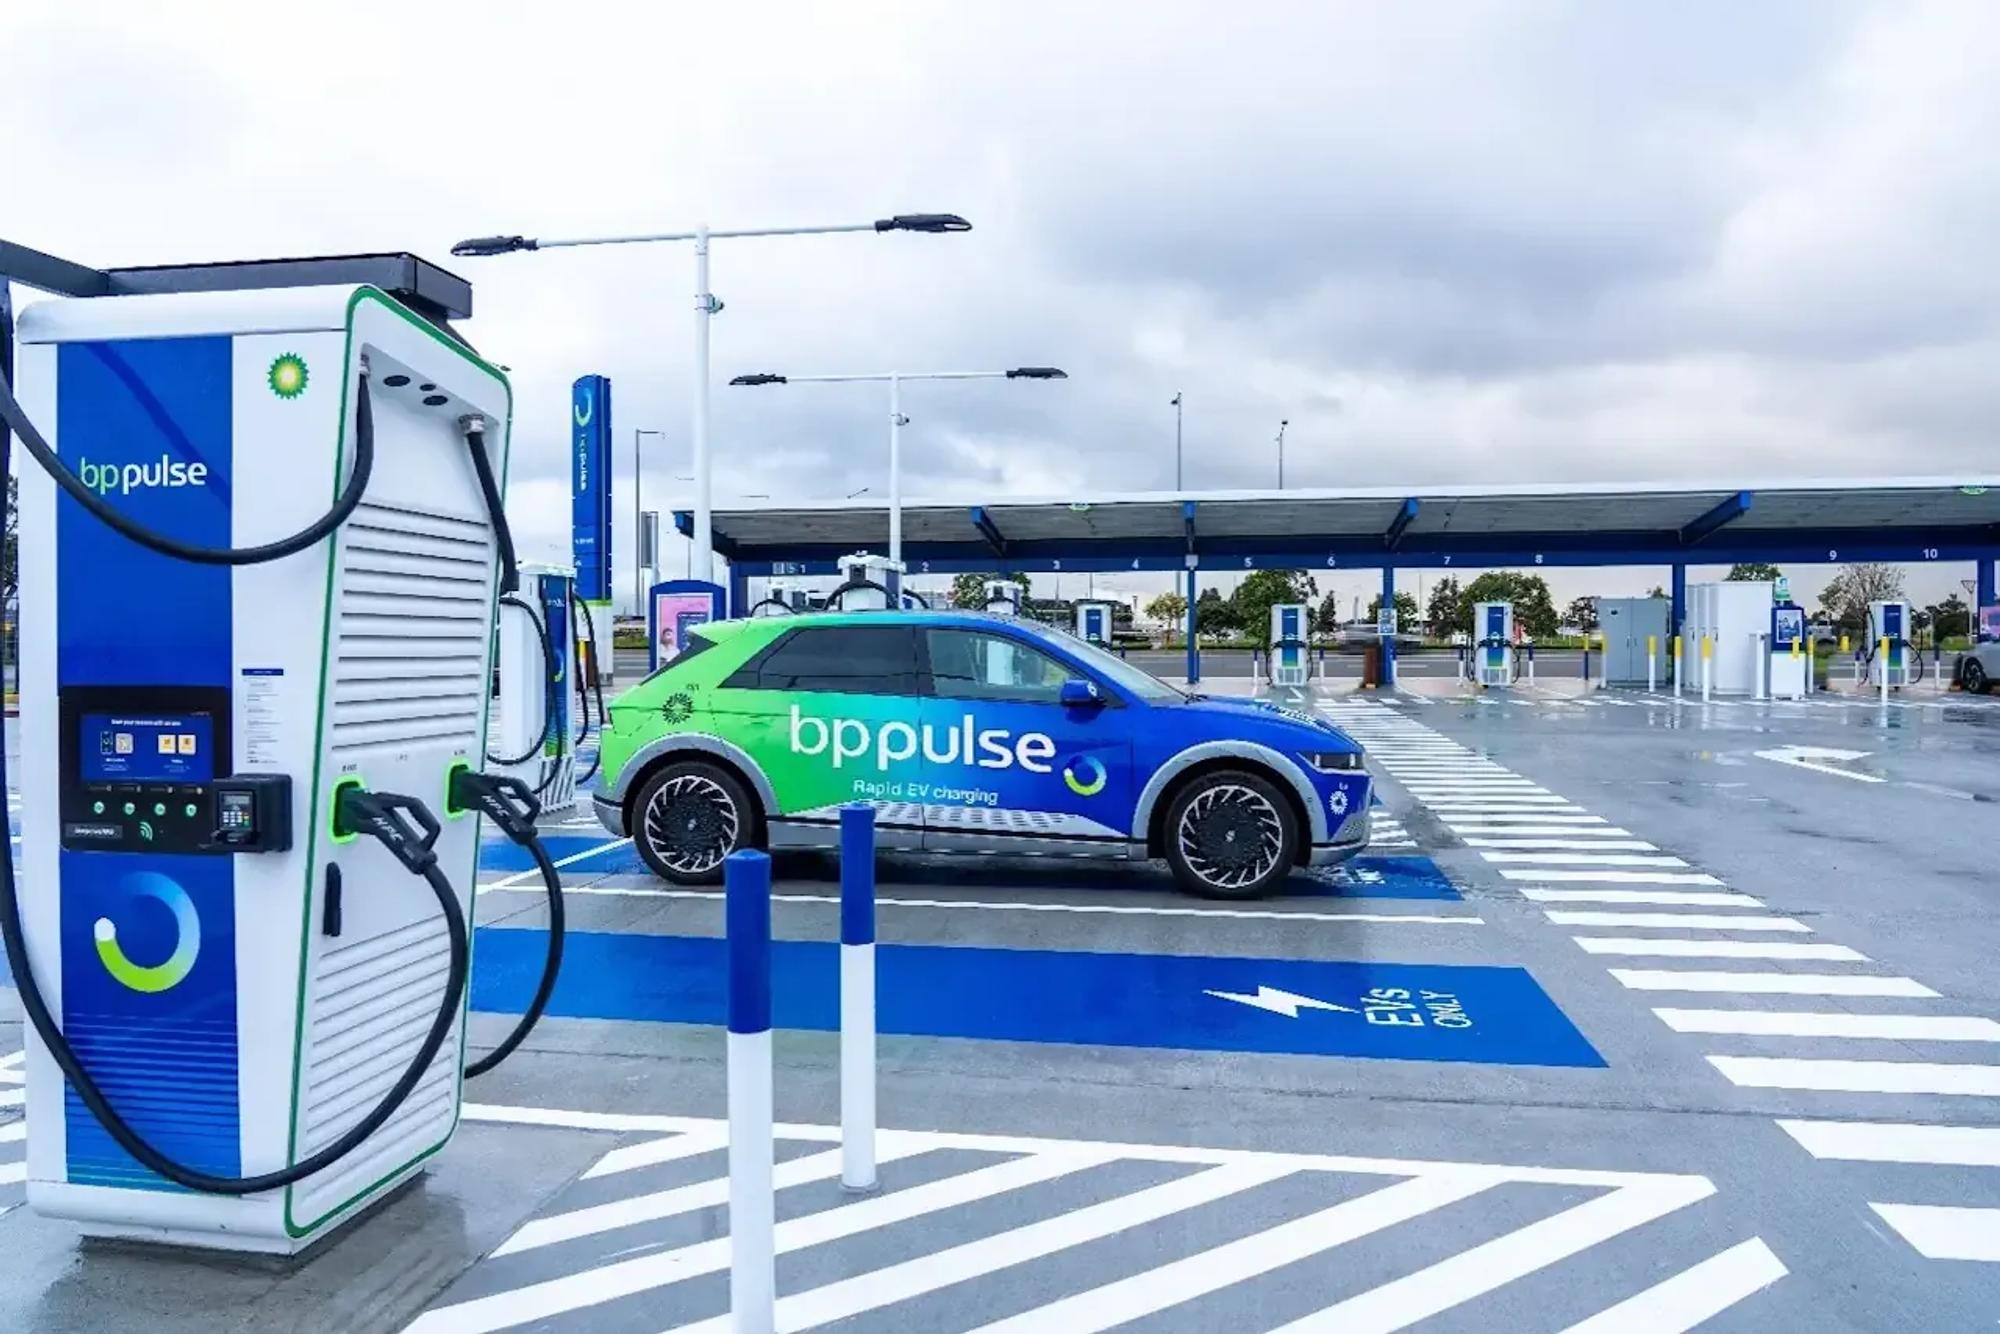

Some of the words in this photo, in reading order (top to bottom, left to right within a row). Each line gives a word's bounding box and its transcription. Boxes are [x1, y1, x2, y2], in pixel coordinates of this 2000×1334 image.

[1828, 549, 1838, 561] 9
[1922, 548, 1939, 560] 10
[921, 561, 930, 572] 2
[1131, 558, 1140, 570] 4
[1244, 556, 1253, 568] 5
[1327, 556, 1336, 567] 6
[1443, 555, 1452, 566] 7
[799, 564, 807, 574] 1
[853, 778, 902, 797] Rapid
[908, 783, 929, 798] EV
[932, 786, 1000, 807] charging
[1419, 989, 1473, 1028] ONLY
